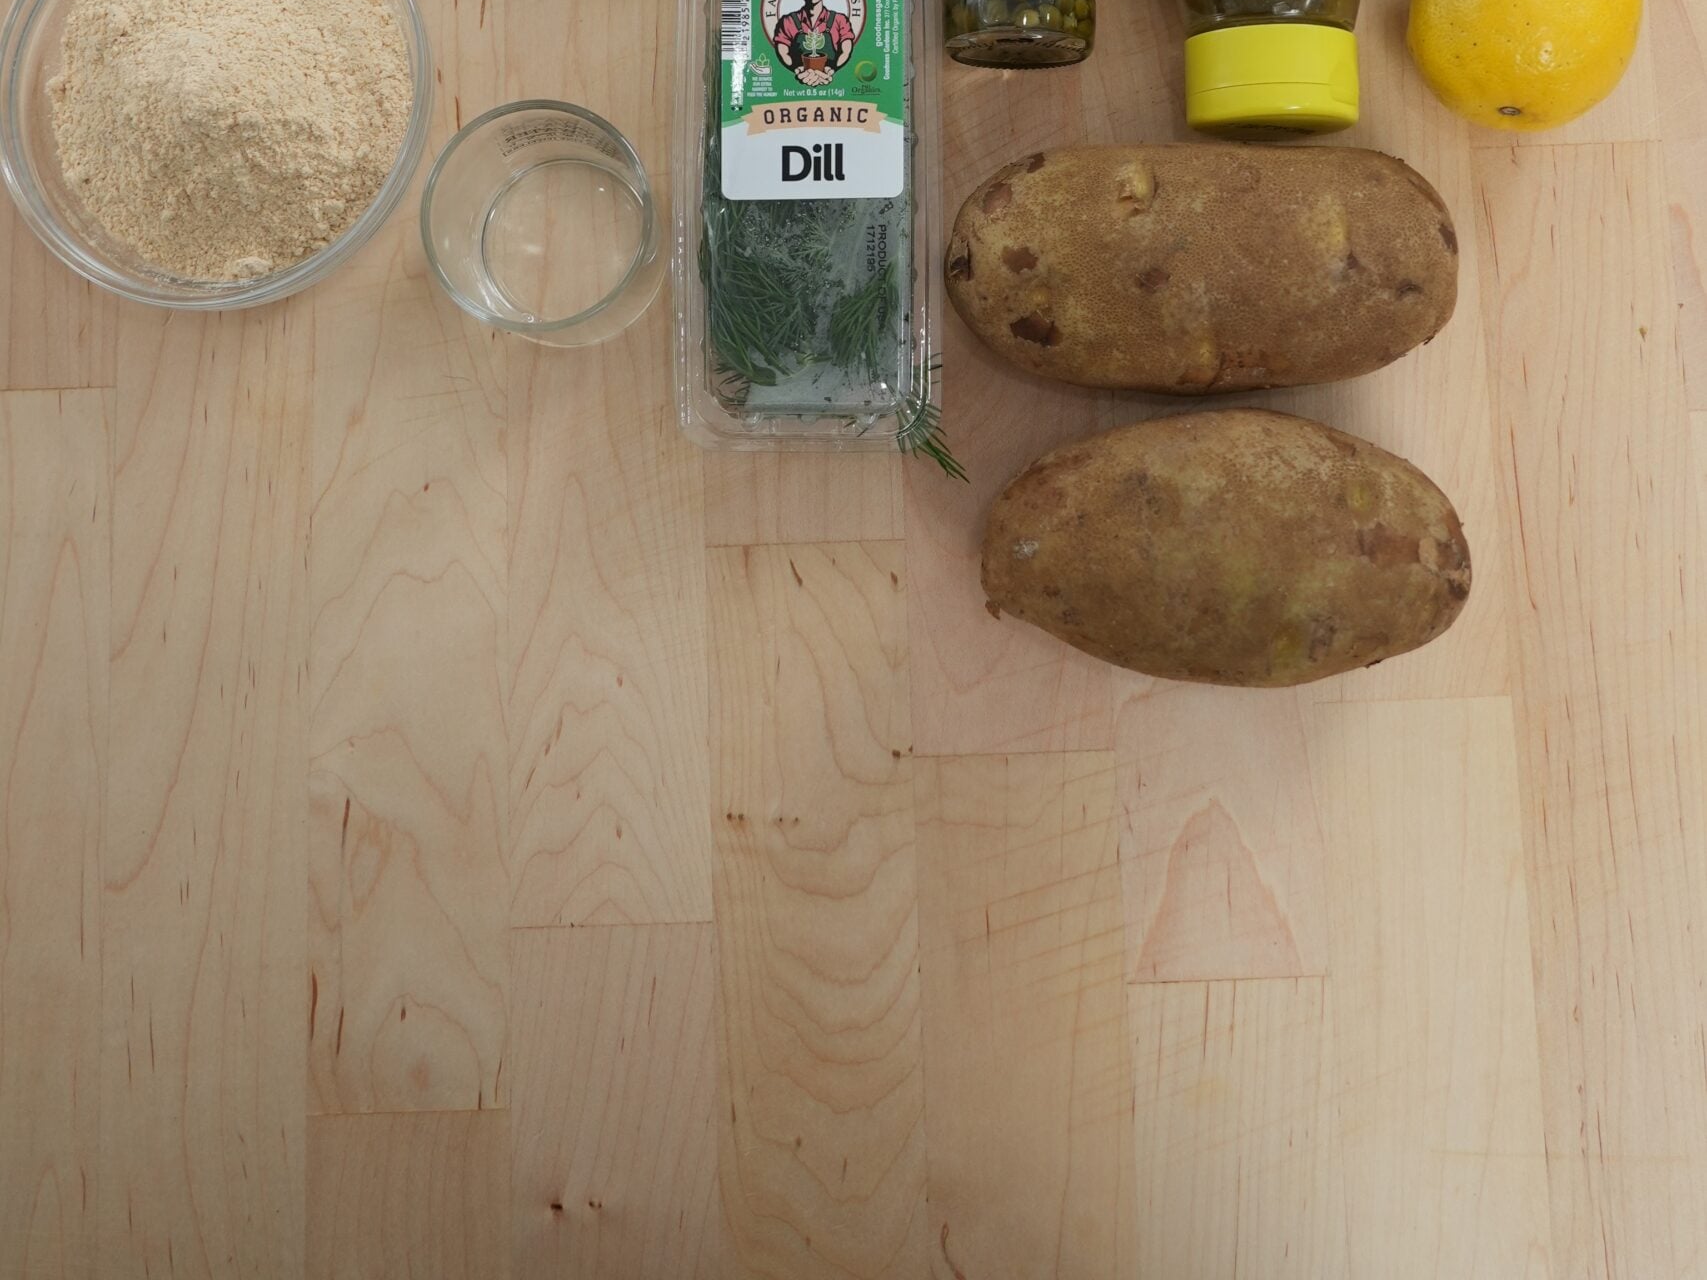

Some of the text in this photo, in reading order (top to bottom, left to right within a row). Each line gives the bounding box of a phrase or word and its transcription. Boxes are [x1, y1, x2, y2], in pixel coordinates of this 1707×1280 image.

[783, 89, 796, 97] Net
[828, 88, 845, 97] (14g)
[763, 108, 870, 125] ORGANIC
[781, 143, 846, 183] Dill
